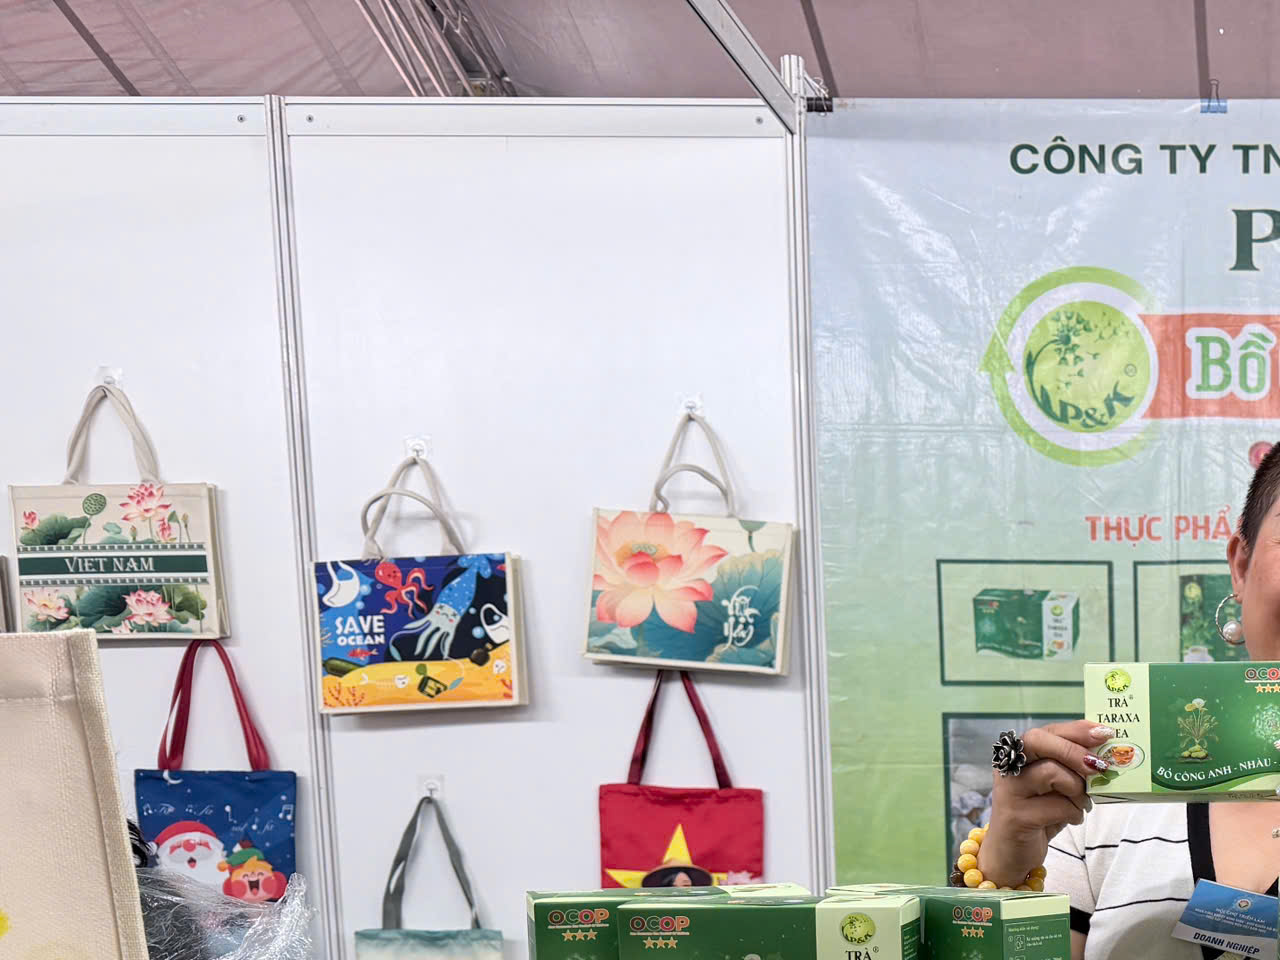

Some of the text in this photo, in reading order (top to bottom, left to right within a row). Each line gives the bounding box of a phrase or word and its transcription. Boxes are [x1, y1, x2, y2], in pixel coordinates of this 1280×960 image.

[1009, 136, 1143, 178] CÔNG
[1160, 144, 1215, 174] TY
[1193, 331, 1272, 395] Bồ
[1057, 380, 1136, 430] P&K
[1085, 504, 1244, 549] THỰC PHẨ
[63, 554, 156, 574] VIET NAM
[334, 615, 385, 636] SAVE
[336, 634, 385, 647] OCEAN
[1108, 696, 1129, 707] TRÀ
[1097, 713, 1140, 723] TARAXA
[1208, 765, 1232, 778] ANH
[1239, 758, 1271, 771] NHÀU
[548, 909, 609, 925] OCOP
[630, 915, 690, 932] OCOP
[953, 906, 992, 922] OCOP
[1193, 932, 1260, 955] DOANH NGHIỆP
